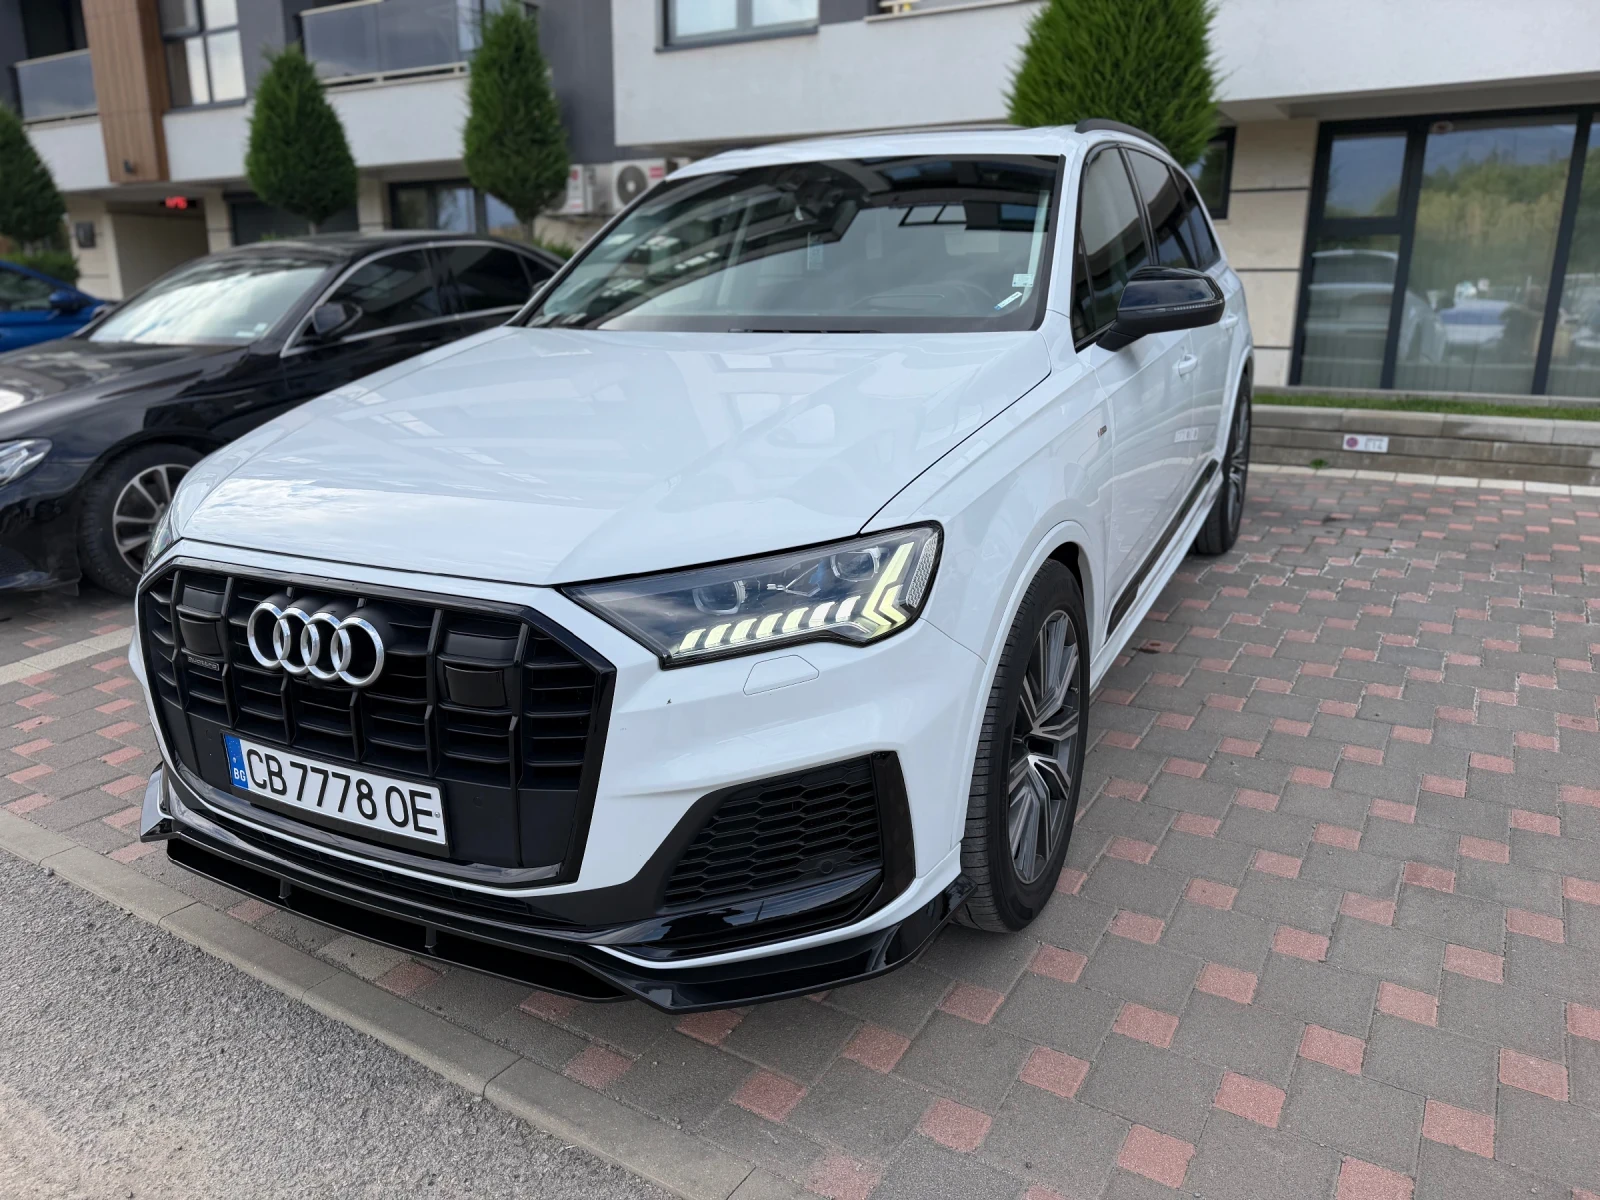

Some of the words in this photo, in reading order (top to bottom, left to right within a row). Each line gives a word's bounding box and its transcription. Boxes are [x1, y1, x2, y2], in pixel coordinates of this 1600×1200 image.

[233, 767, 247, 782] BG
[247, 749, 287, 796] CB
[289, 761, 378, 821] 7778
[385, 785, 438, 836] OE
